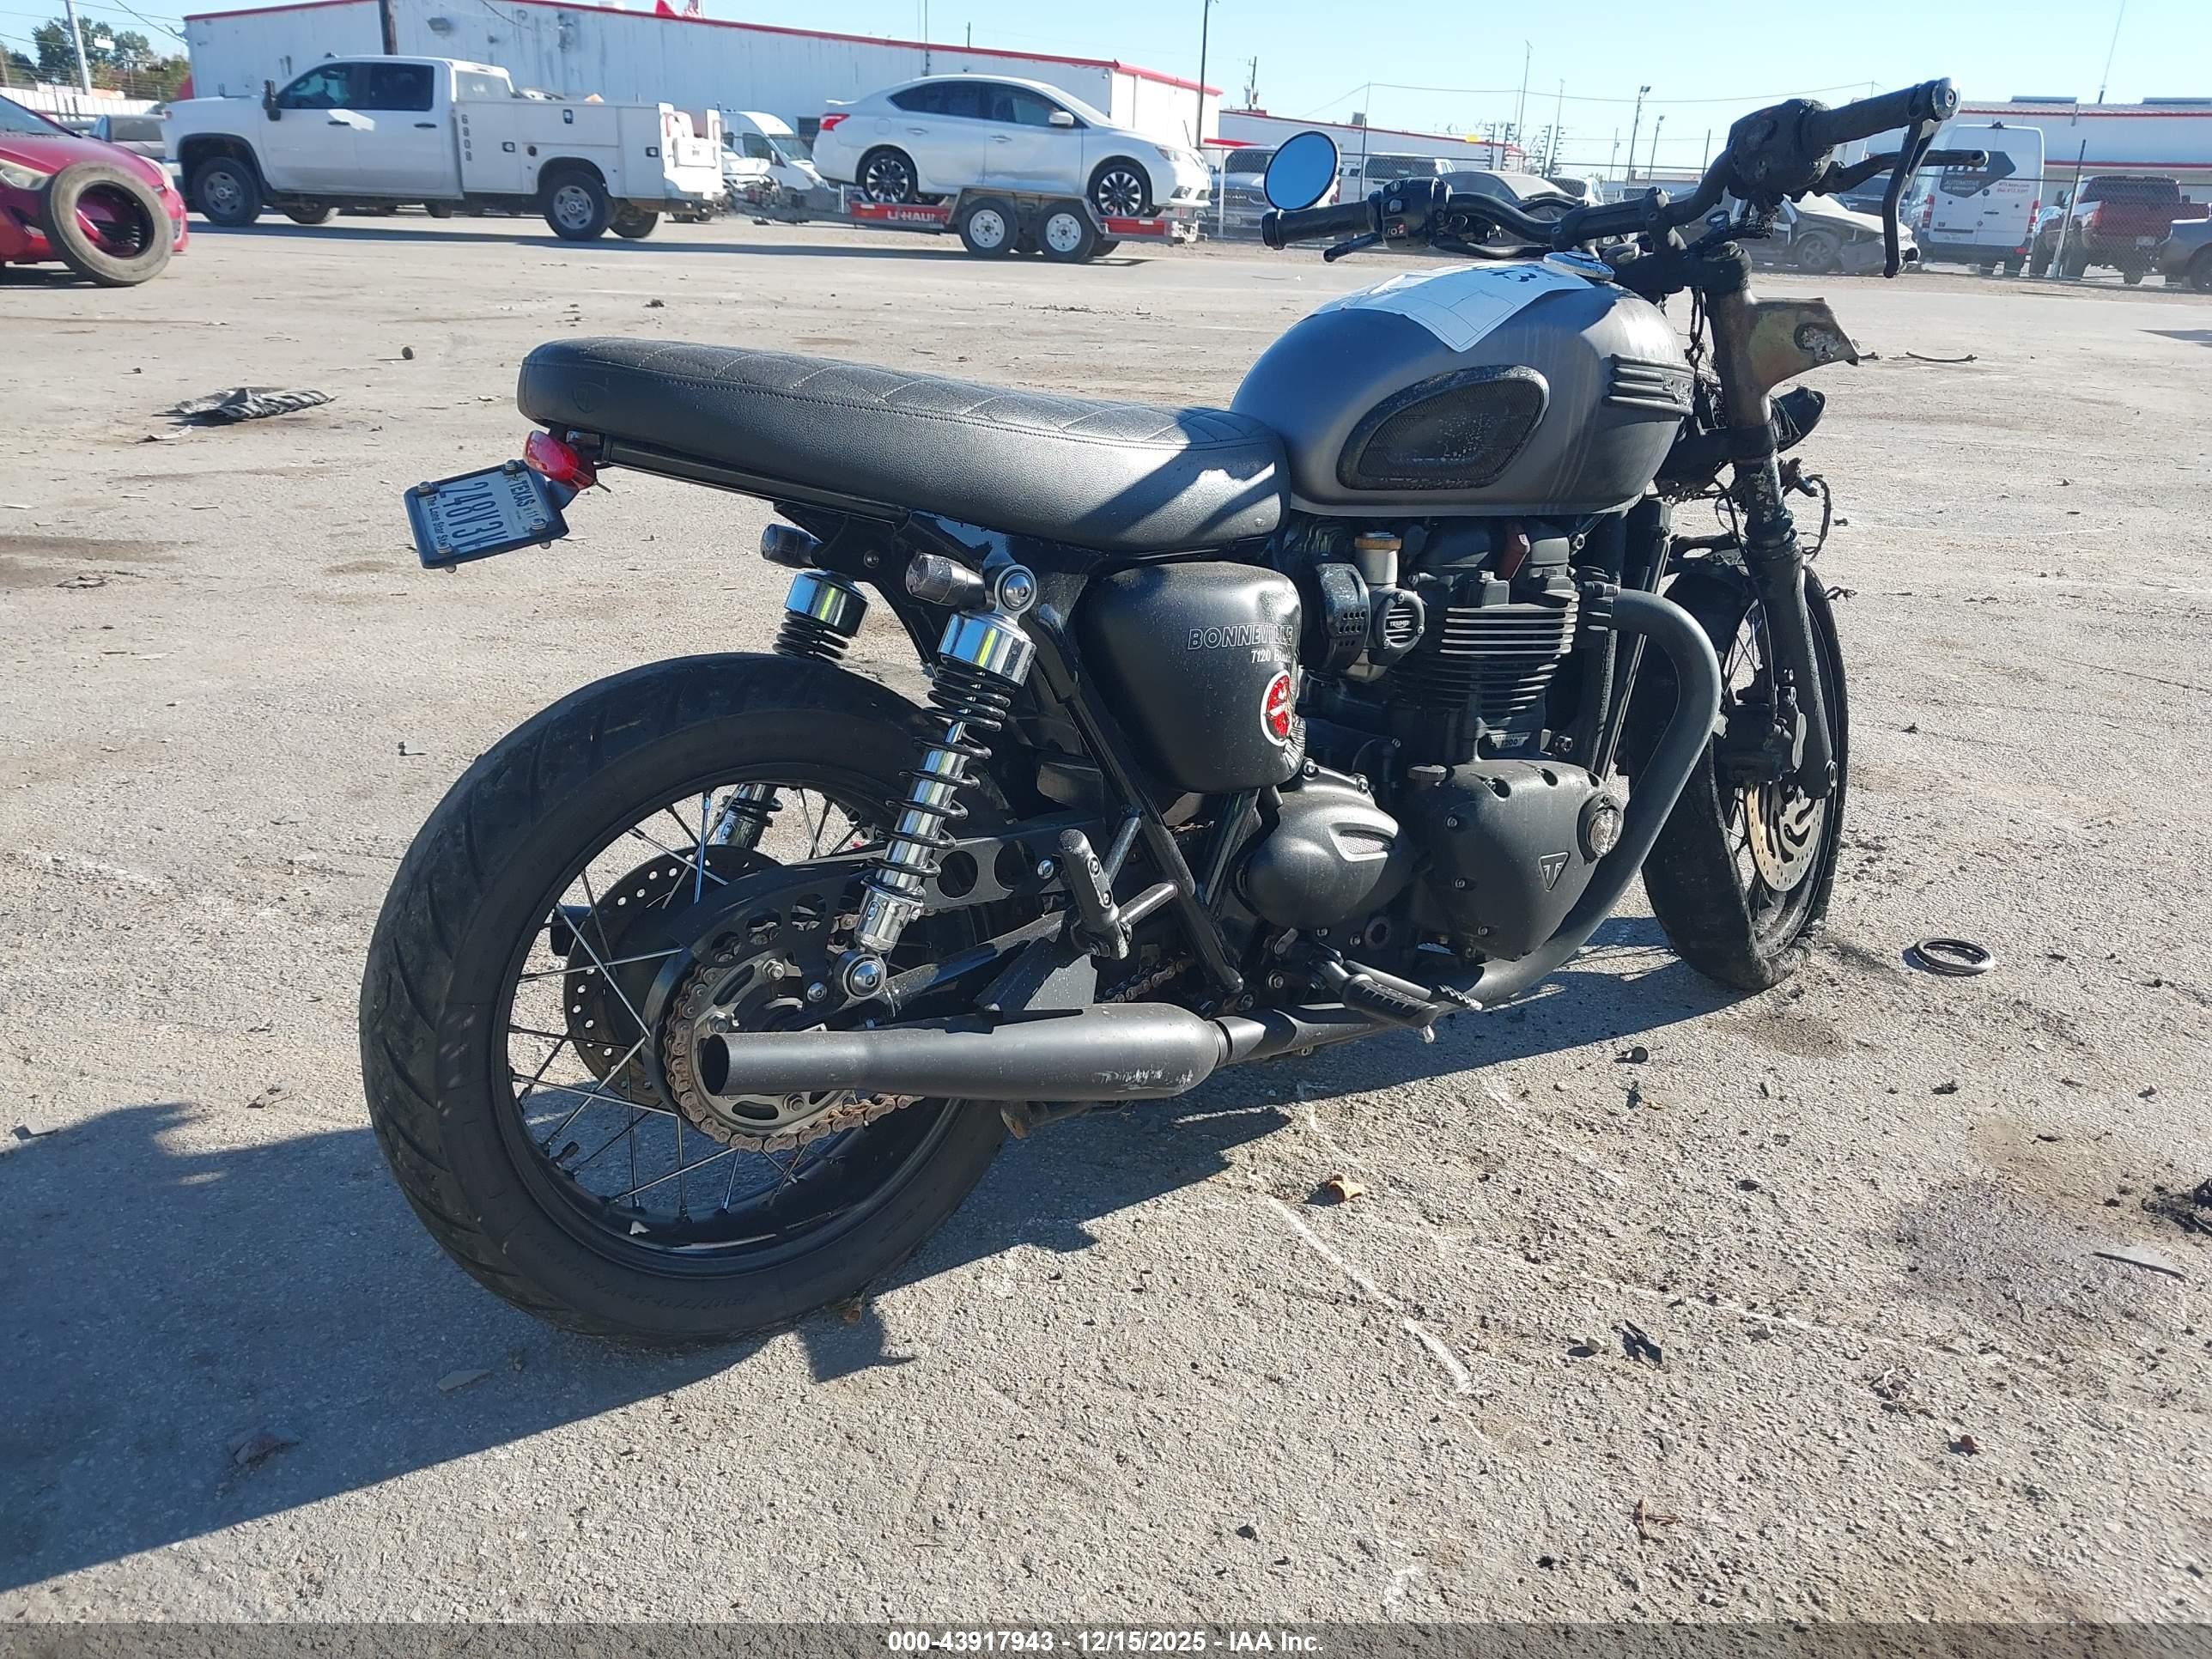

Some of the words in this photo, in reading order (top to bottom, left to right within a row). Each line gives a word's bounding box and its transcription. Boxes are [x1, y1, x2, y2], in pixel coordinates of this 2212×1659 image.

[426, 495, 437, 507] The
[508, 479, 536, 508] TEXAS
[429, 506, 441, 522] Lone
[432, 521, 447, 534] Star
[1188, 623, 1294, 650] BONNEVILLE
[1250, 649, 1272, 664] T120
[1273, 648, 1291, 662] Bla
